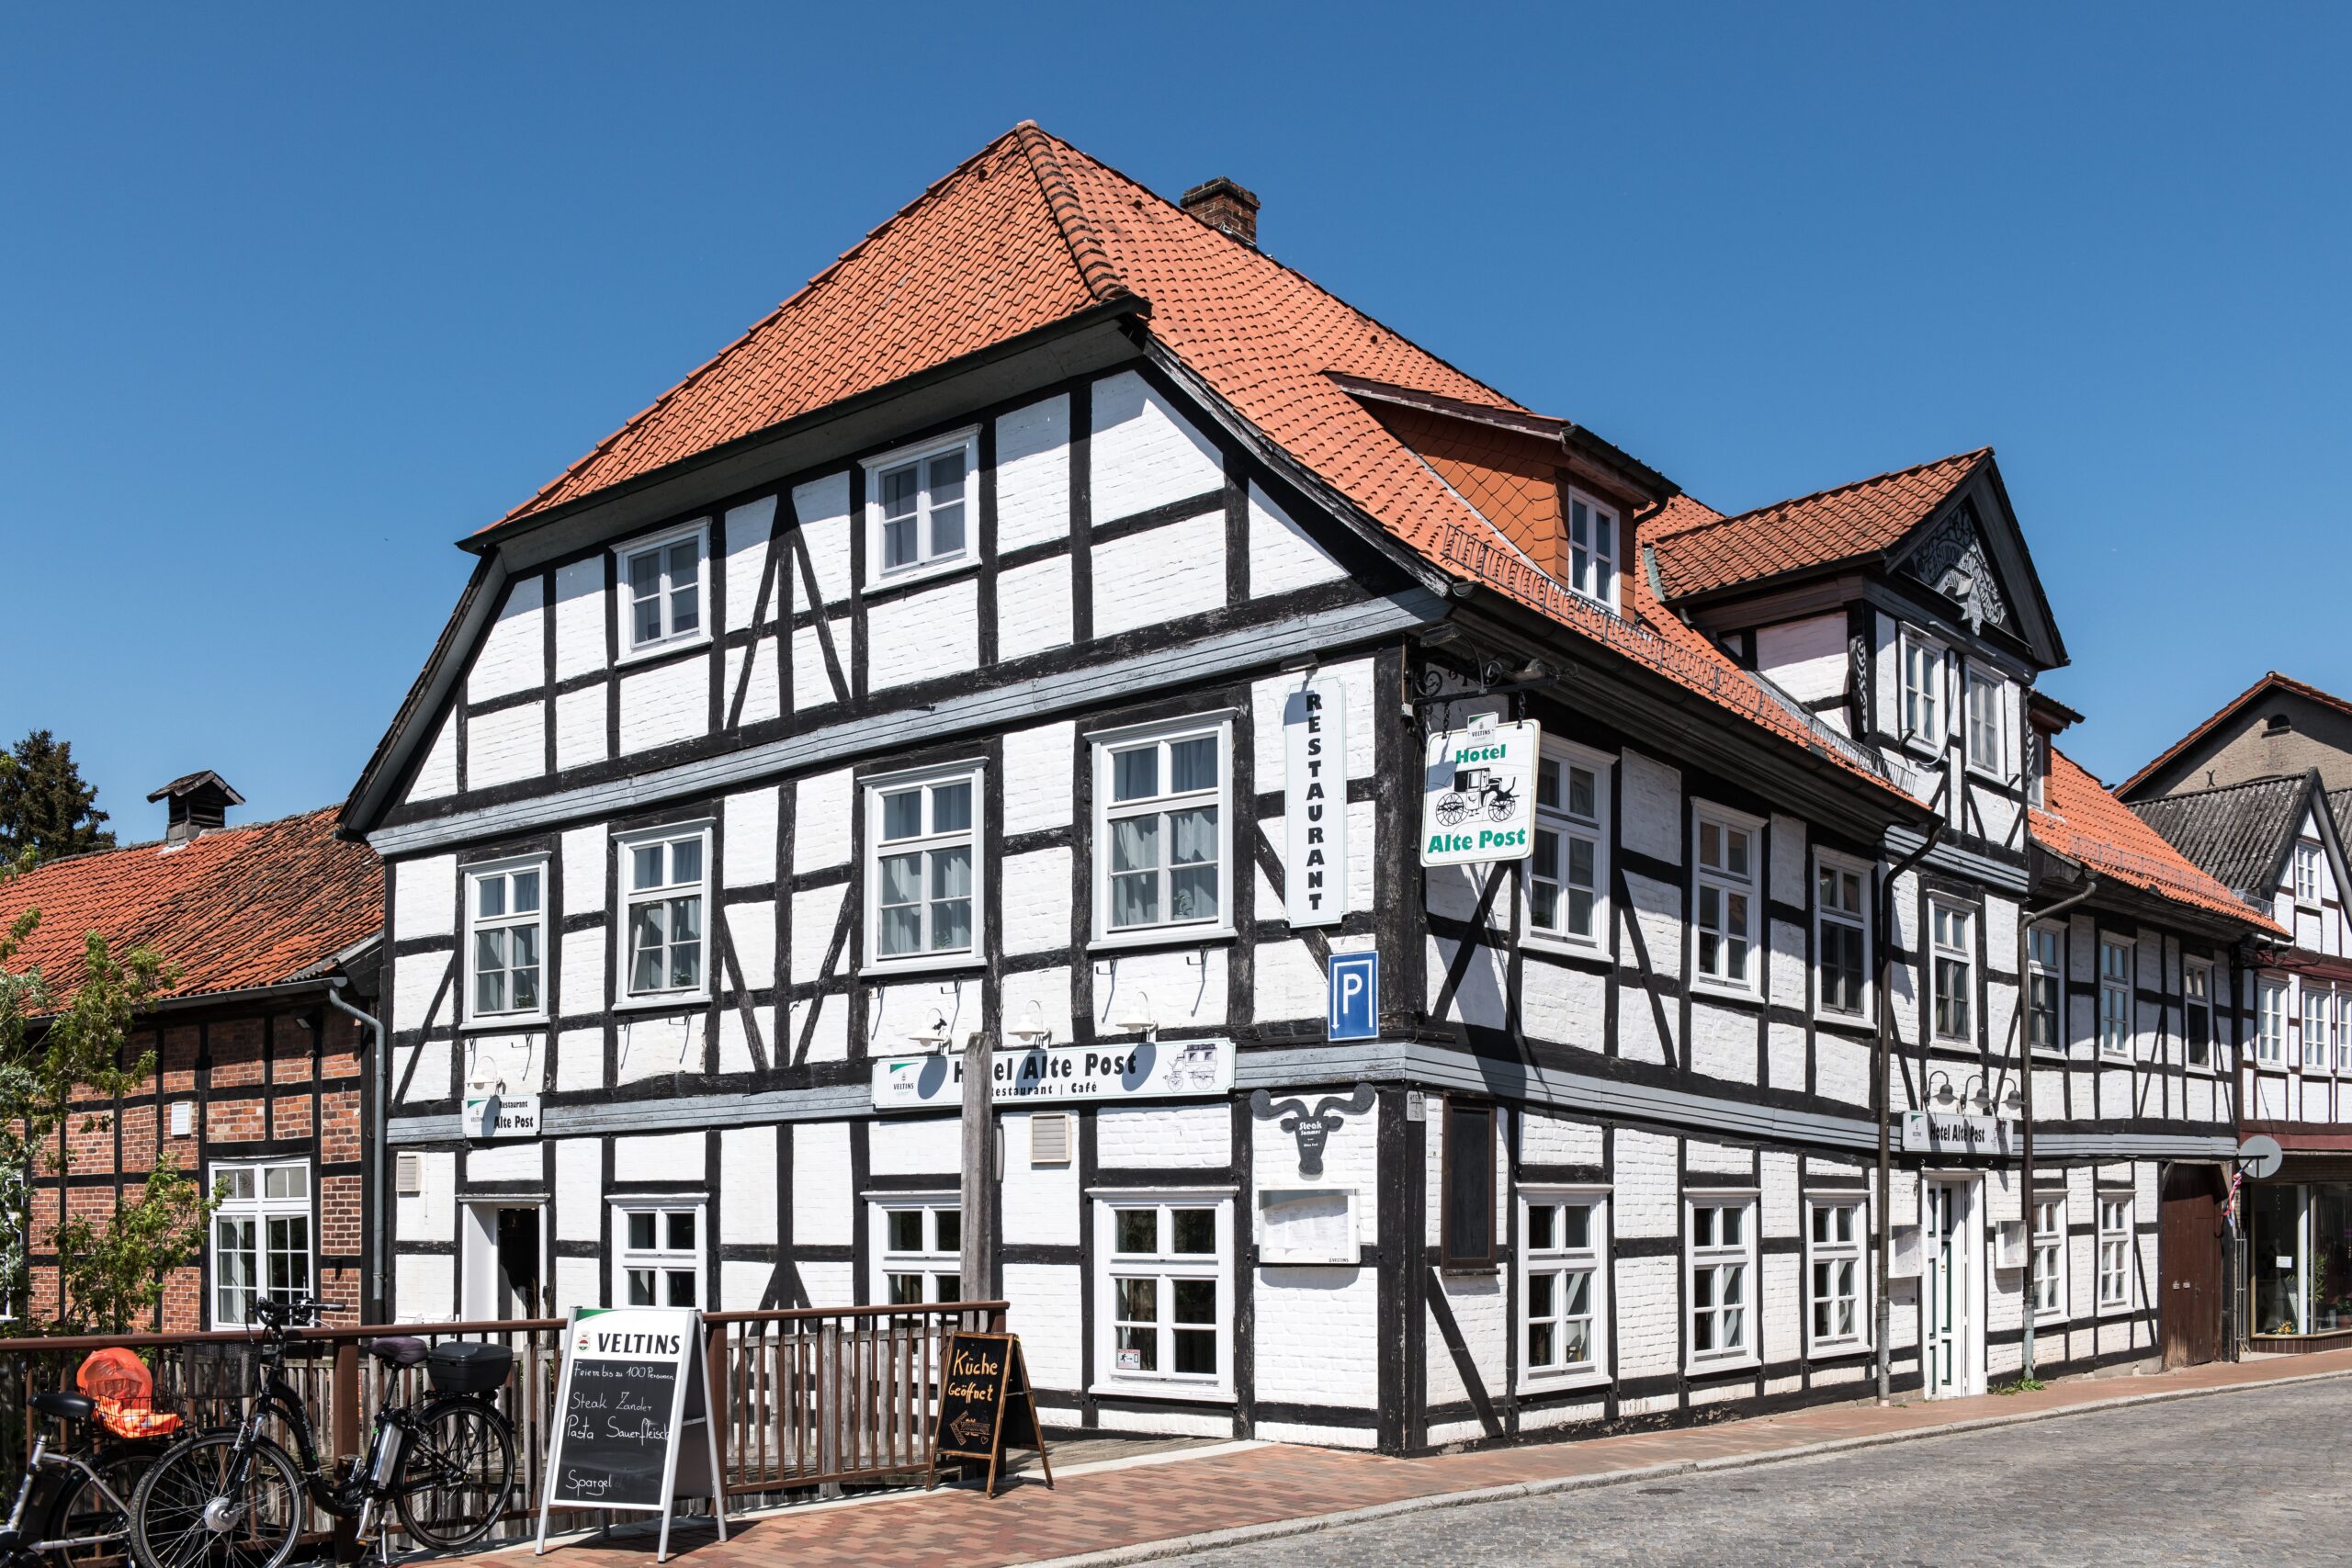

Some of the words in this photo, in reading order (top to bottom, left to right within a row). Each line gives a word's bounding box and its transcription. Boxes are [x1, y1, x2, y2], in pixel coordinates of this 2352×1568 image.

[1455, 743, 1507, 763] Hotel
[1306, 694, 1325, 911] RESTAURANT
[1427, 833, 1473, 853] Alte
[1478, 827, 1526, 849] Post
[1342, 973, 1363, 1014] P
[954, 1057, 1013, 1083] Hel
[1023, 1055, 1072, 1079] Alte
[1085, 1051, 1136, 1076] Post
[991, 1084, 1053, 1097] estaurant
[1070, 1081, 1097, 1093] Café
[499, 1100, 528, 1109] Restaurant
[493, 1115, 512, 1129] Alte
[514, 1115, 534, 1128] Post
[1298, 1121, 1322, 1131] Steak
[1929, 1122, 1951, 1141] Hotel
[1951, 1124, 1968, 1142] Alte
[1970, 1125, 1985, 1143] Post
[597, 1332, 681, 1355] VELTINS
[602, 1363, 614, 1378] bis
[626, 1366, 647, 1378] 100
[647, 1366, 675, 1381] Personen
[953, 1348, 999, 1376] Küche
[570, 1392, 607, 1410] Steak
[616, 1392, 652, 1412] Zander
[948, 1382, 994, 1404] Geöffnet
[566, 1414, 594, 1440] Pasta
[605, 1416, 671, 1446] Sauerfleisch
[565, 1469, 613, 1497] Spargel
